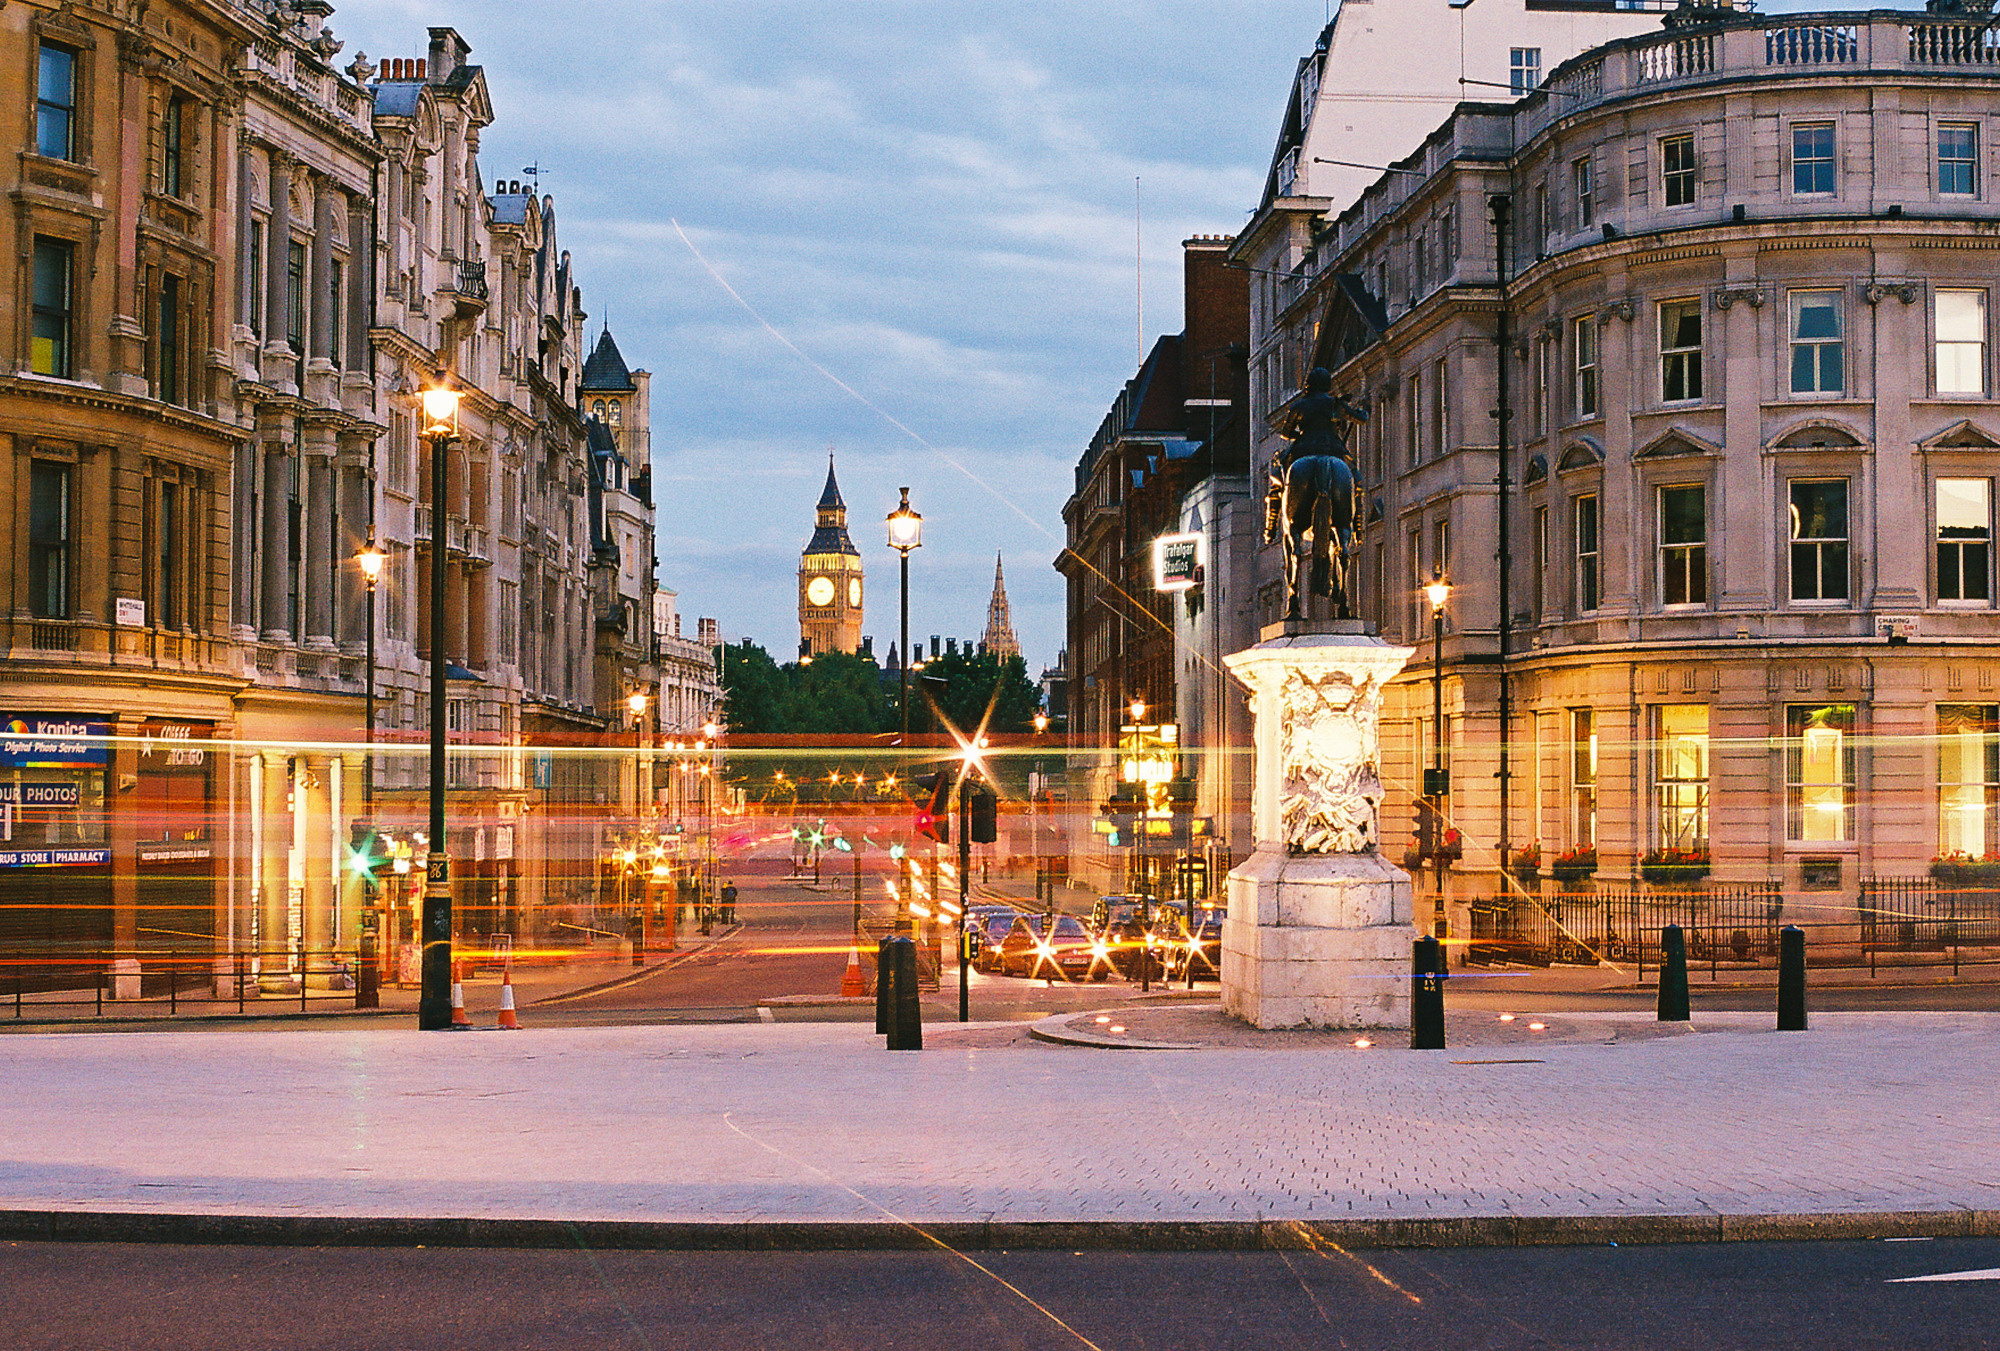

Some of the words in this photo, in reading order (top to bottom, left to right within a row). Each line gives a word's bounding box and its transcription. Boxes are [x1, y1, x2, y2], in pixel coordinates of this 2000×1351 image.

[1163, 543, 1194, 558] Trafalgar
[1163, 560, 1188, 573] Studios
[36, 721, 87, 736] Konica
[4, 741, 33, 755] Digital
[34, 741, 58, 753] Photo
[58, 742, 87, 754] Service
[188, 749, 204, 766] GO
[27, 787, 77, 801] PHOTOS
[20, 852, 48, 863] STORE
[55, 851, 105, 862] PHARMACY
